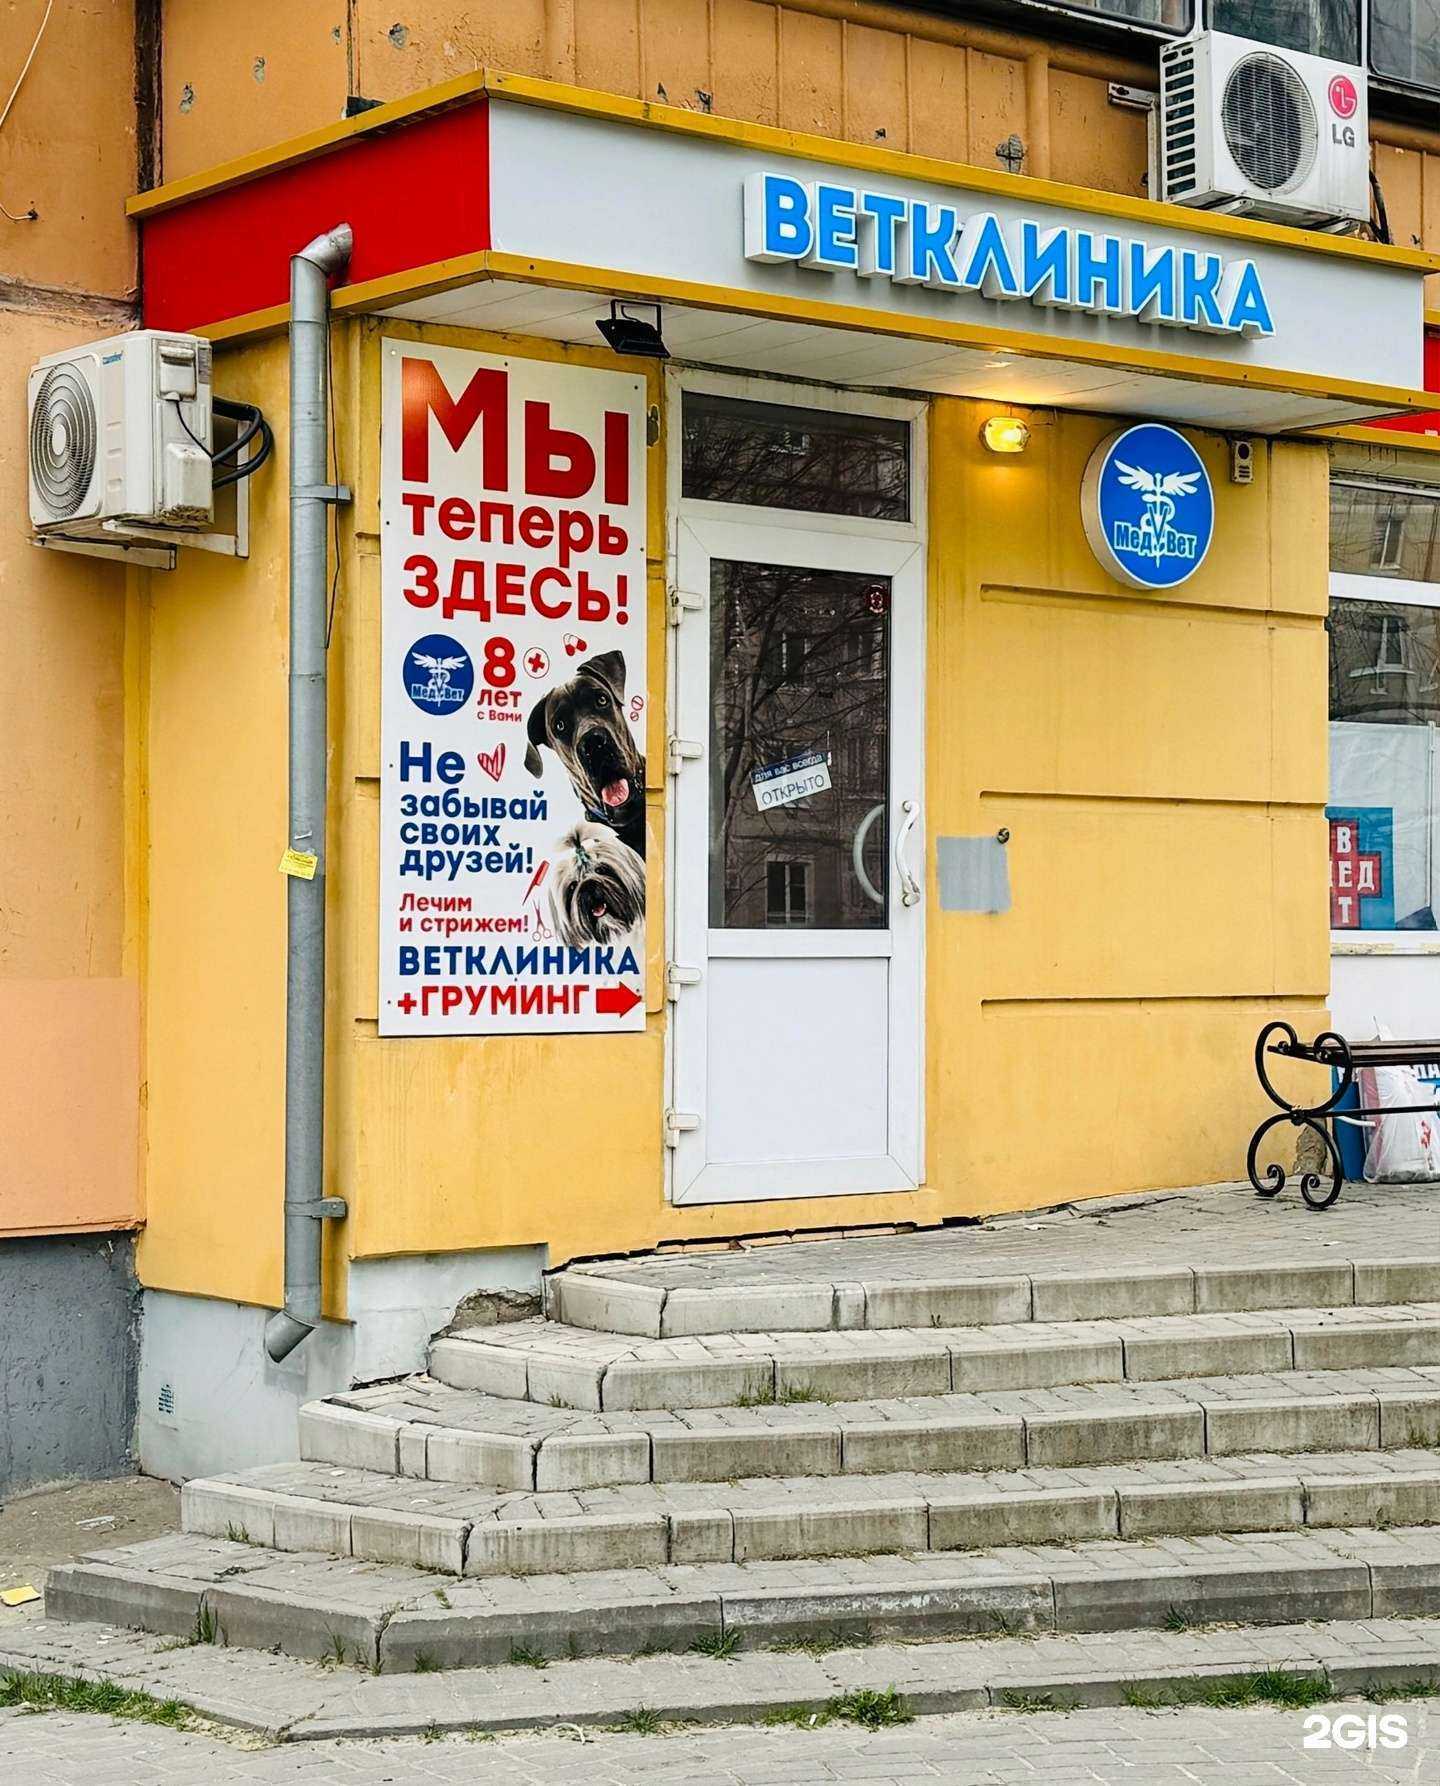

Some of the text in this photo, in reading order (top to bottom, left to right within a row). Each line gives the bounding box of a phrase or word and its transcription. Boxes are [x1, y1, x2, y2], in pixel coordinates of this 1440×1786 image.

[1331, 123, 1355, 148] LG
[760, 171, 1275, 337] ВЕТКЛИНИКА
[402, 356, 629, 506] Мы
[402, 492, 629, 569] теперь
[403, 554, 629, 625] ЗДЕСЬ!
[483, 636, 516, 688] 8
[477, 689, 522, 708] лет
[489, 709, 522, 722] Вами
[400, 741, 466, 784] Не
[400, 788, 547, 820] забывай
[762, 774, 824, 805] ОТКРЫТО
[400, 822, 500, 846] своих
[399, 842, 533, 881] друзей!
[399, 893, 472, 912] Лечим
[399, 915, 529, 938] и стрижем!
[399, 945, 640, 975] ВЕТКЛИНИКА
